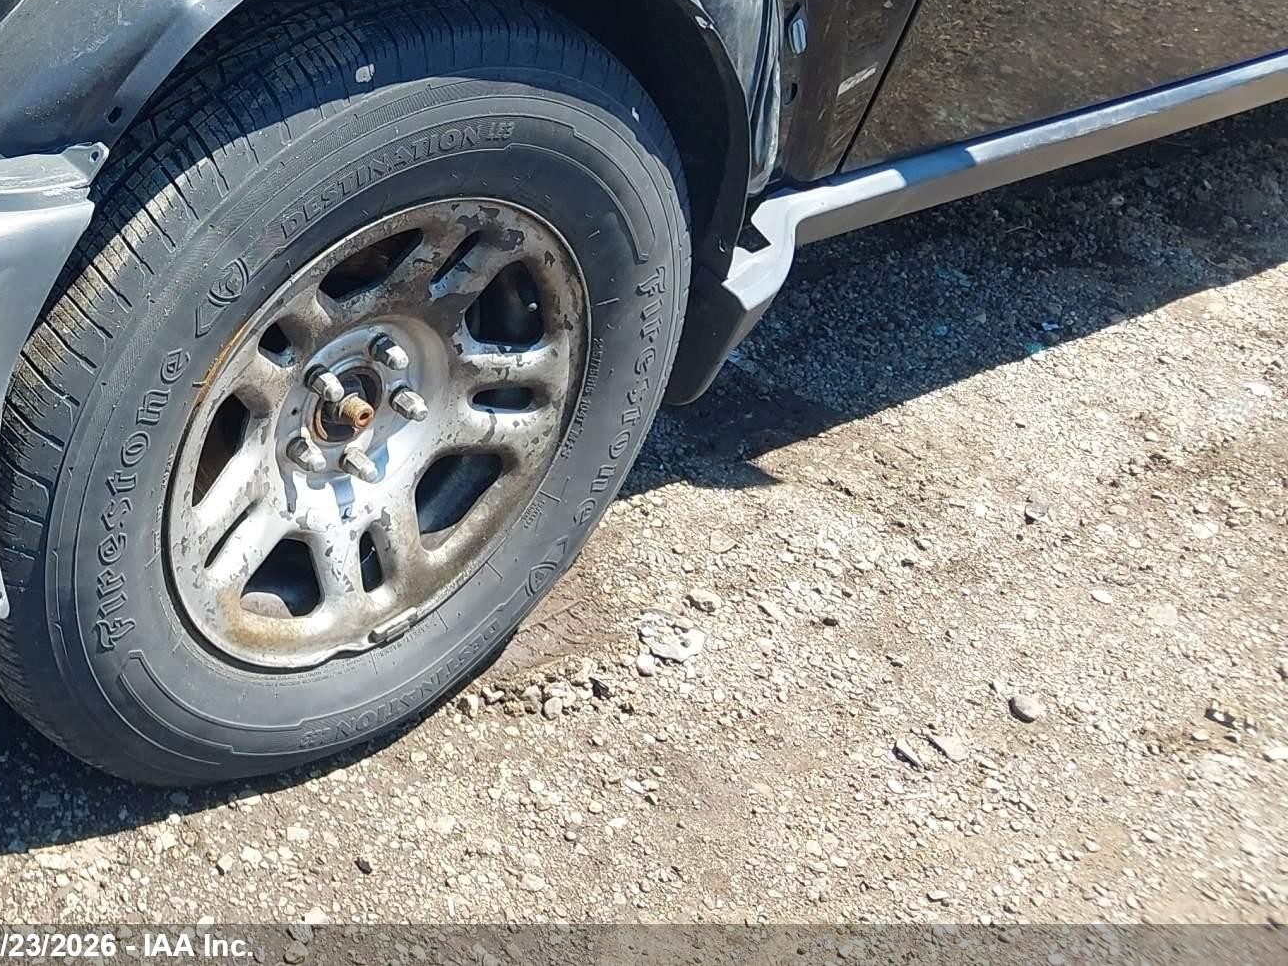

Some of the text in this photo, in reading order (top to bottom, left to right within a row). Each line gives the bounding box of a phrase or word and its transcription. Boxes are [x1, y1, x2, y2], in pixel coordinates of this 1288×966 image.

[281, 125, 481, 239] DESTINATION
[573, 265, 667, 526] Firestone
[94, 346, 192, 651] Firestone
[335, 616, 501, 741] DESTINATION
